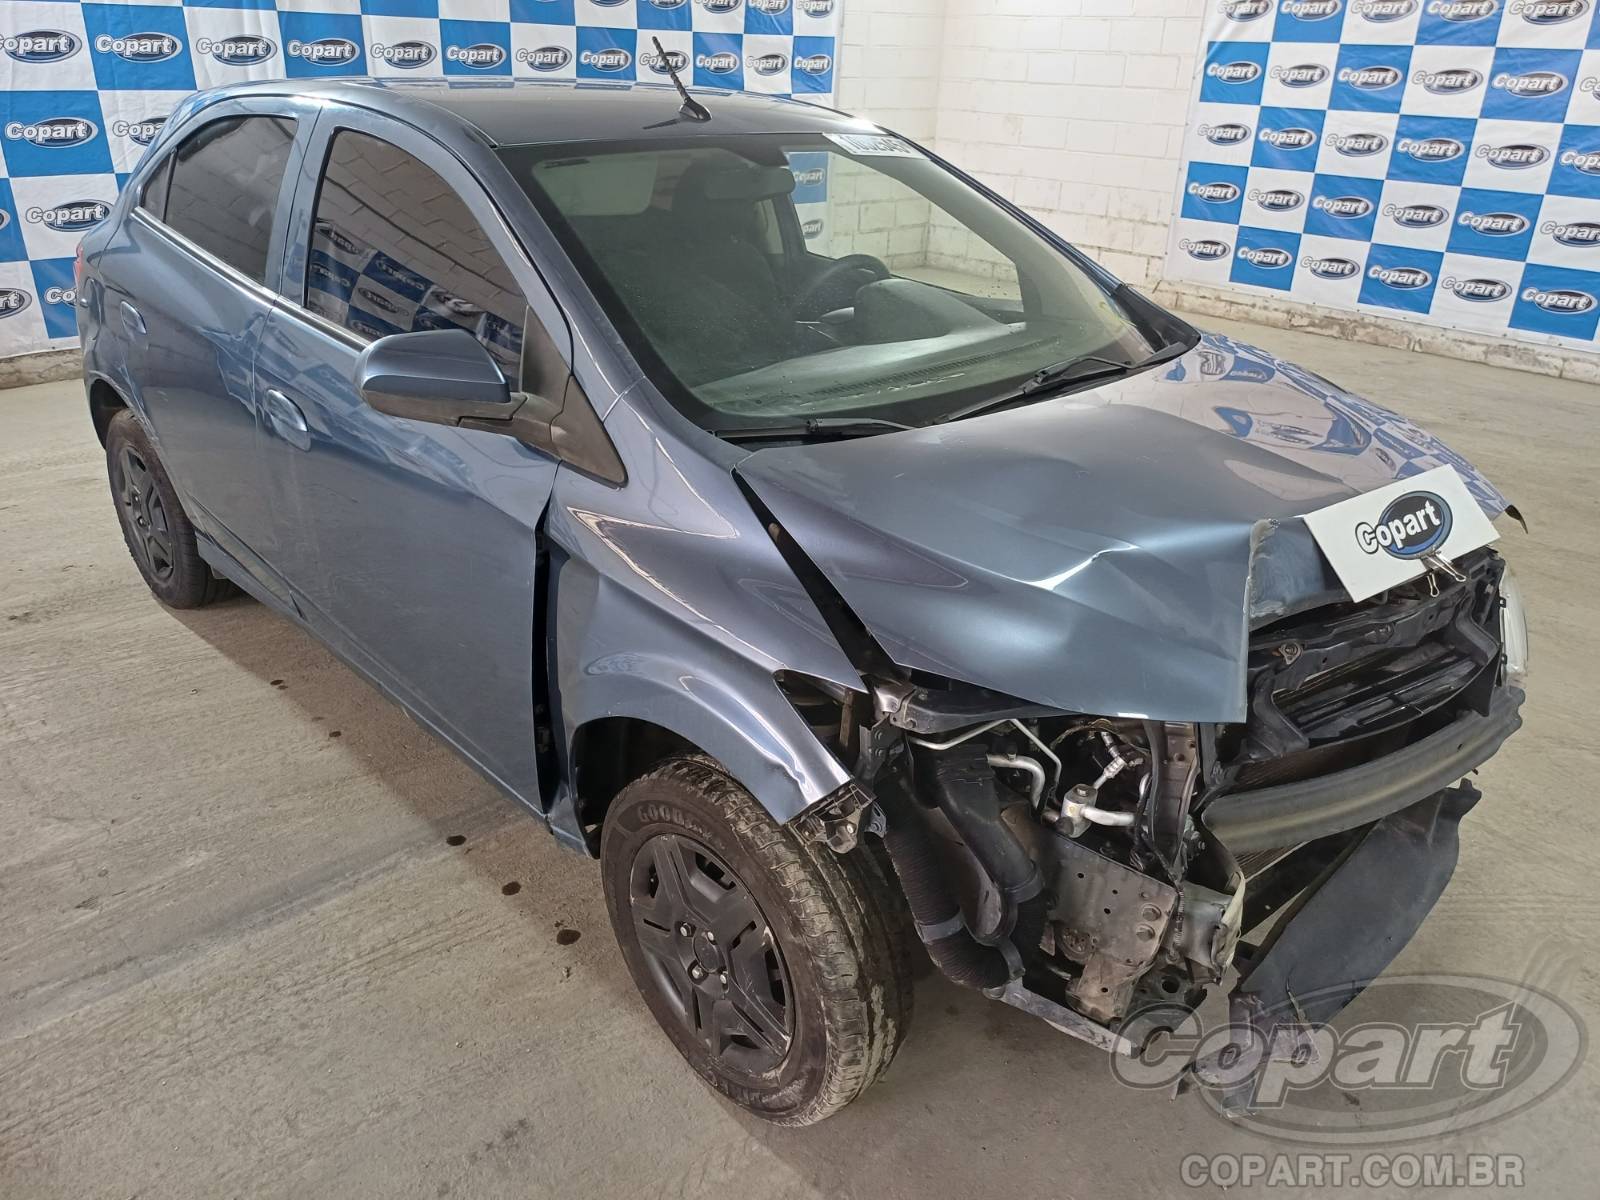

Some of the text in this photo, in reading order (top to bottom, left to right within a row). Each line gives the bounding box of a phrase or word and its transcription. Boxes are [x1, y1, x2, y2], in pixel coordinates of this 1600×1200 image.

[1280, 0, 1338, 15] Copart
[1351, 0, 1409, 17] Copart
[1426, 0, 1490, 16] Copart
[1508, 0, 1579, 17] Copart
[96, 34, 172, 57] Copart
[196, 38, 267, 58] Copart
[288, 40, 351, 59] Copart
[371, 43, 427, 60] Copart
[447, 45, 500, 65] Copart
[516, 48, 564, 65] Copart
[580, 51, 626, 67] Copart
[696, 54, 734, 70] Copart
[746, 56, 782, 71] Copart
[794, 56, 828, 71] Copart
[1206, 62, 1256, 80] Copart
[1269, 65, 1324, 83] Copart
[1338, 67, 1394, 86] Copart
[1412, 70, 1474, 89] Copart
[1491, 73, 1563, 91] Copart
[6, 121, 87, 143] Copart
[1197, 124, 1244, 140] Copart
[1259, 128, 1310, 146] Copart
[1325, 133, 1379, 150] Copart
[1397, 138, 1459, 157] Copart
[1475, 144, 1540, 163] Copart
[1187, 182, 1234, 199] Copart
[1248, 189, 1297, 206] Copart
[1312, 195, 1367, 214] Copart
[1382, 204, 1441, 223] Copart
[26, 205, 104, 228] Copart
[1457, 211, 1521, 231] Copart
[1540, 220, 1600, 242] Copar
[1179, 239, 1226, 256] Copart
[1237, 247, 1286, 264] Copart
[1300, 256, 1352, 275] Copart
[1367, 264, 1425, 286] Copart
[1441, 277, 1505, 297] Copart
[1521, 287, 1590, 310] Copart
[1355, 498, 1441, 554] Copart
